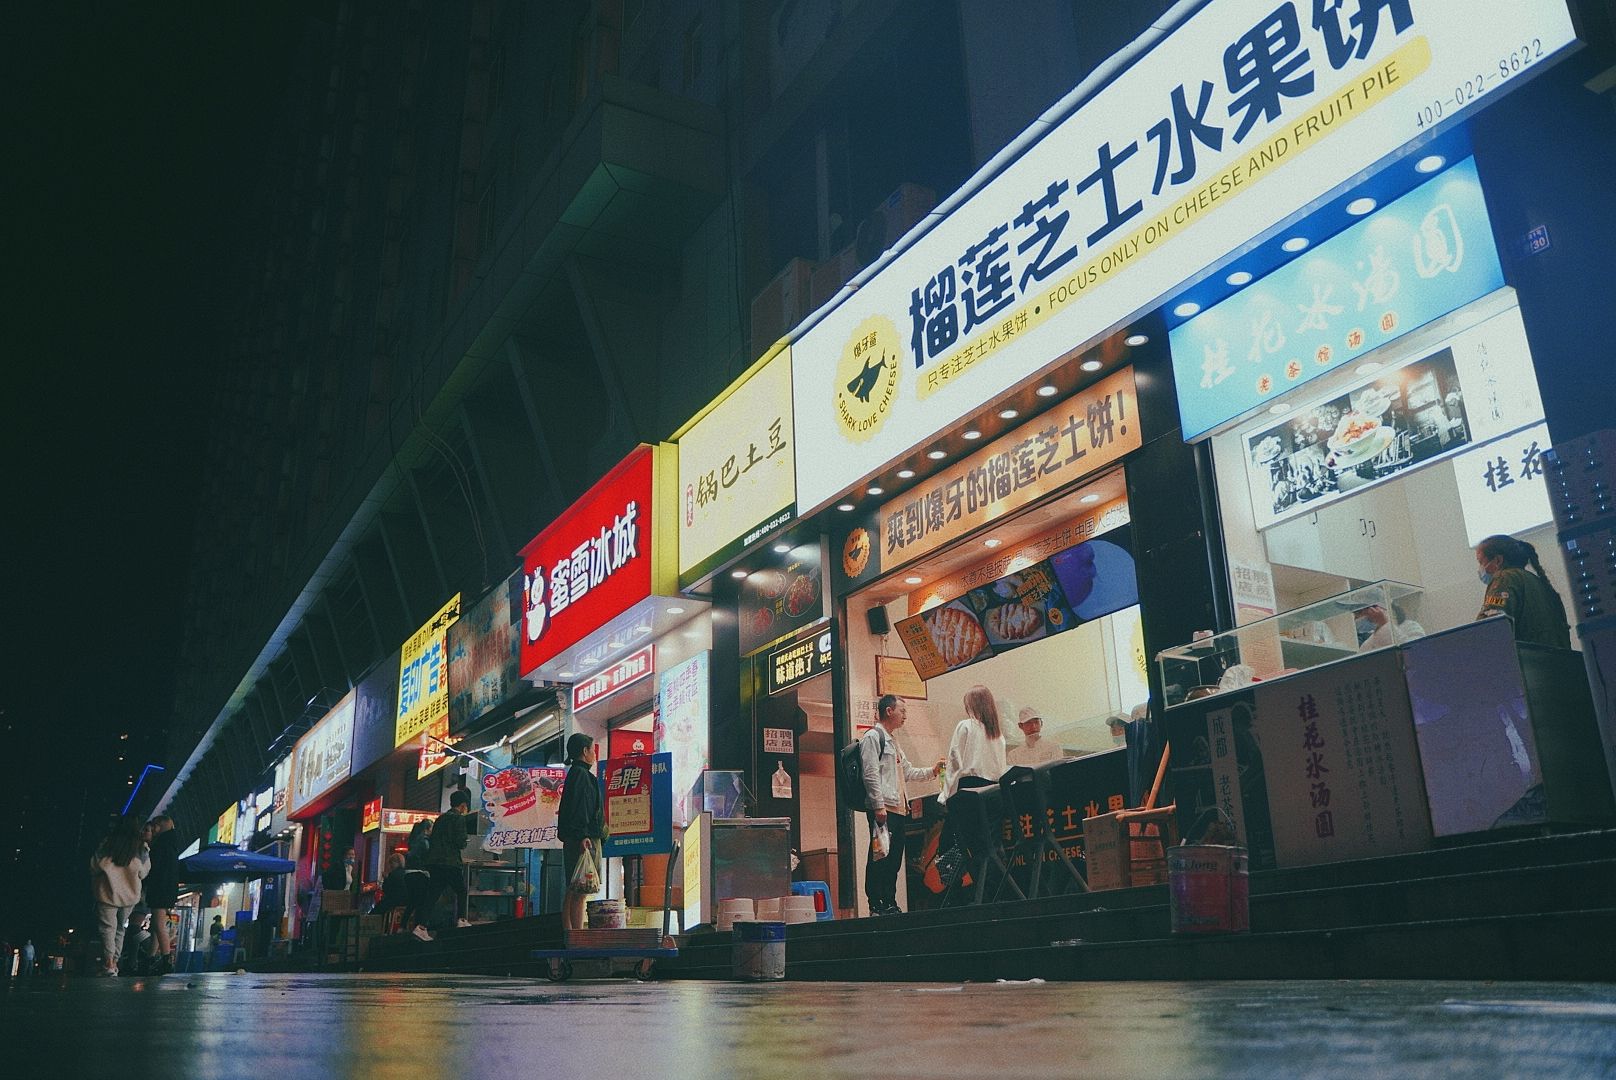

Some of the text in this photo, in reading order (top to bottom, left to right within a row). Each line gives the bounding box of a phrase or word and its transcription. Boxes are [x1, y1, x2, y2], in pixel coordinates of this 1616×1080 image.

[1416, 37, 1545, 129] 400-022-8622
[909, 0, 1415, 369] 榴莲芝士水果饼
[926, 59, 1401, 391] 只专注芝士水果饼 FOCUS ONLY ON CHEESE AND FRUIT PIE
[838, 360, 898, 433] SHARK LOVE CHEESE
[696, 417, 787, 509] 锅巴土豆
[887, 389, 1128, 555] 爽到爆牙的榴莲芝士饼!
[550, 500, 637, 618] 蜜雪冰城
[608, 767, 643, 796] 急聘
